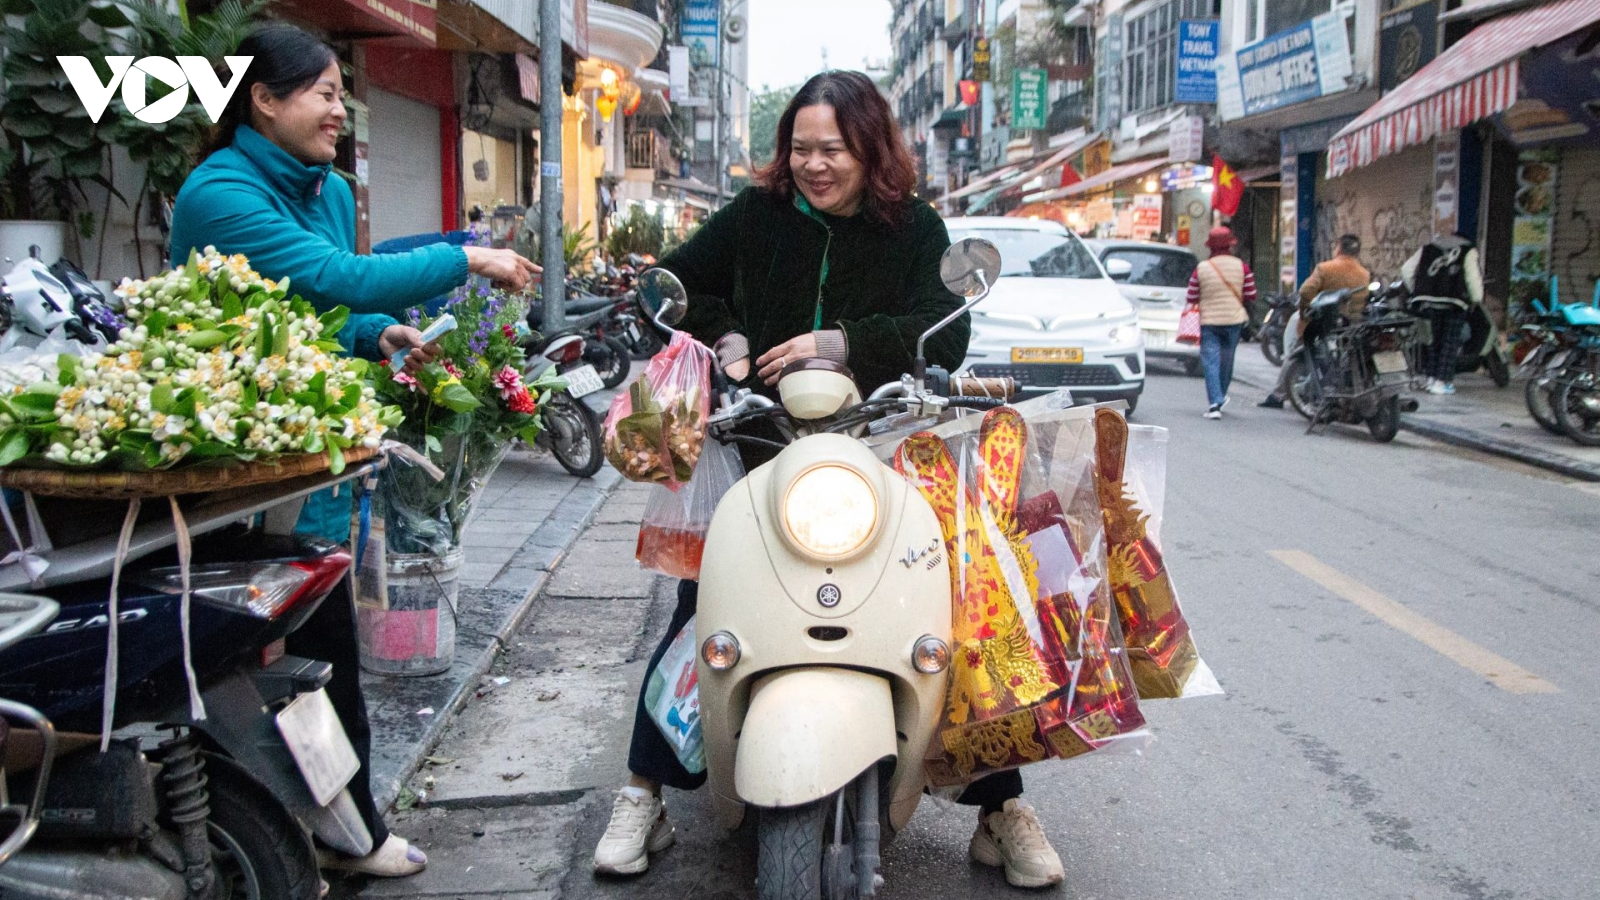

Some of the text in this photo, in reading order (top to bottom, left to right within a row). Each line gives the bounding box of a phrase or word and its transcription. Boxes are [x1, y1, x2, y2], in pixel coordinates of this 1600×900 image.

[1188, 23, 1211, 38] TONY
[1183, 40, 1215, 55] TRAVEL
[46, 608, 148, 632] EAD
